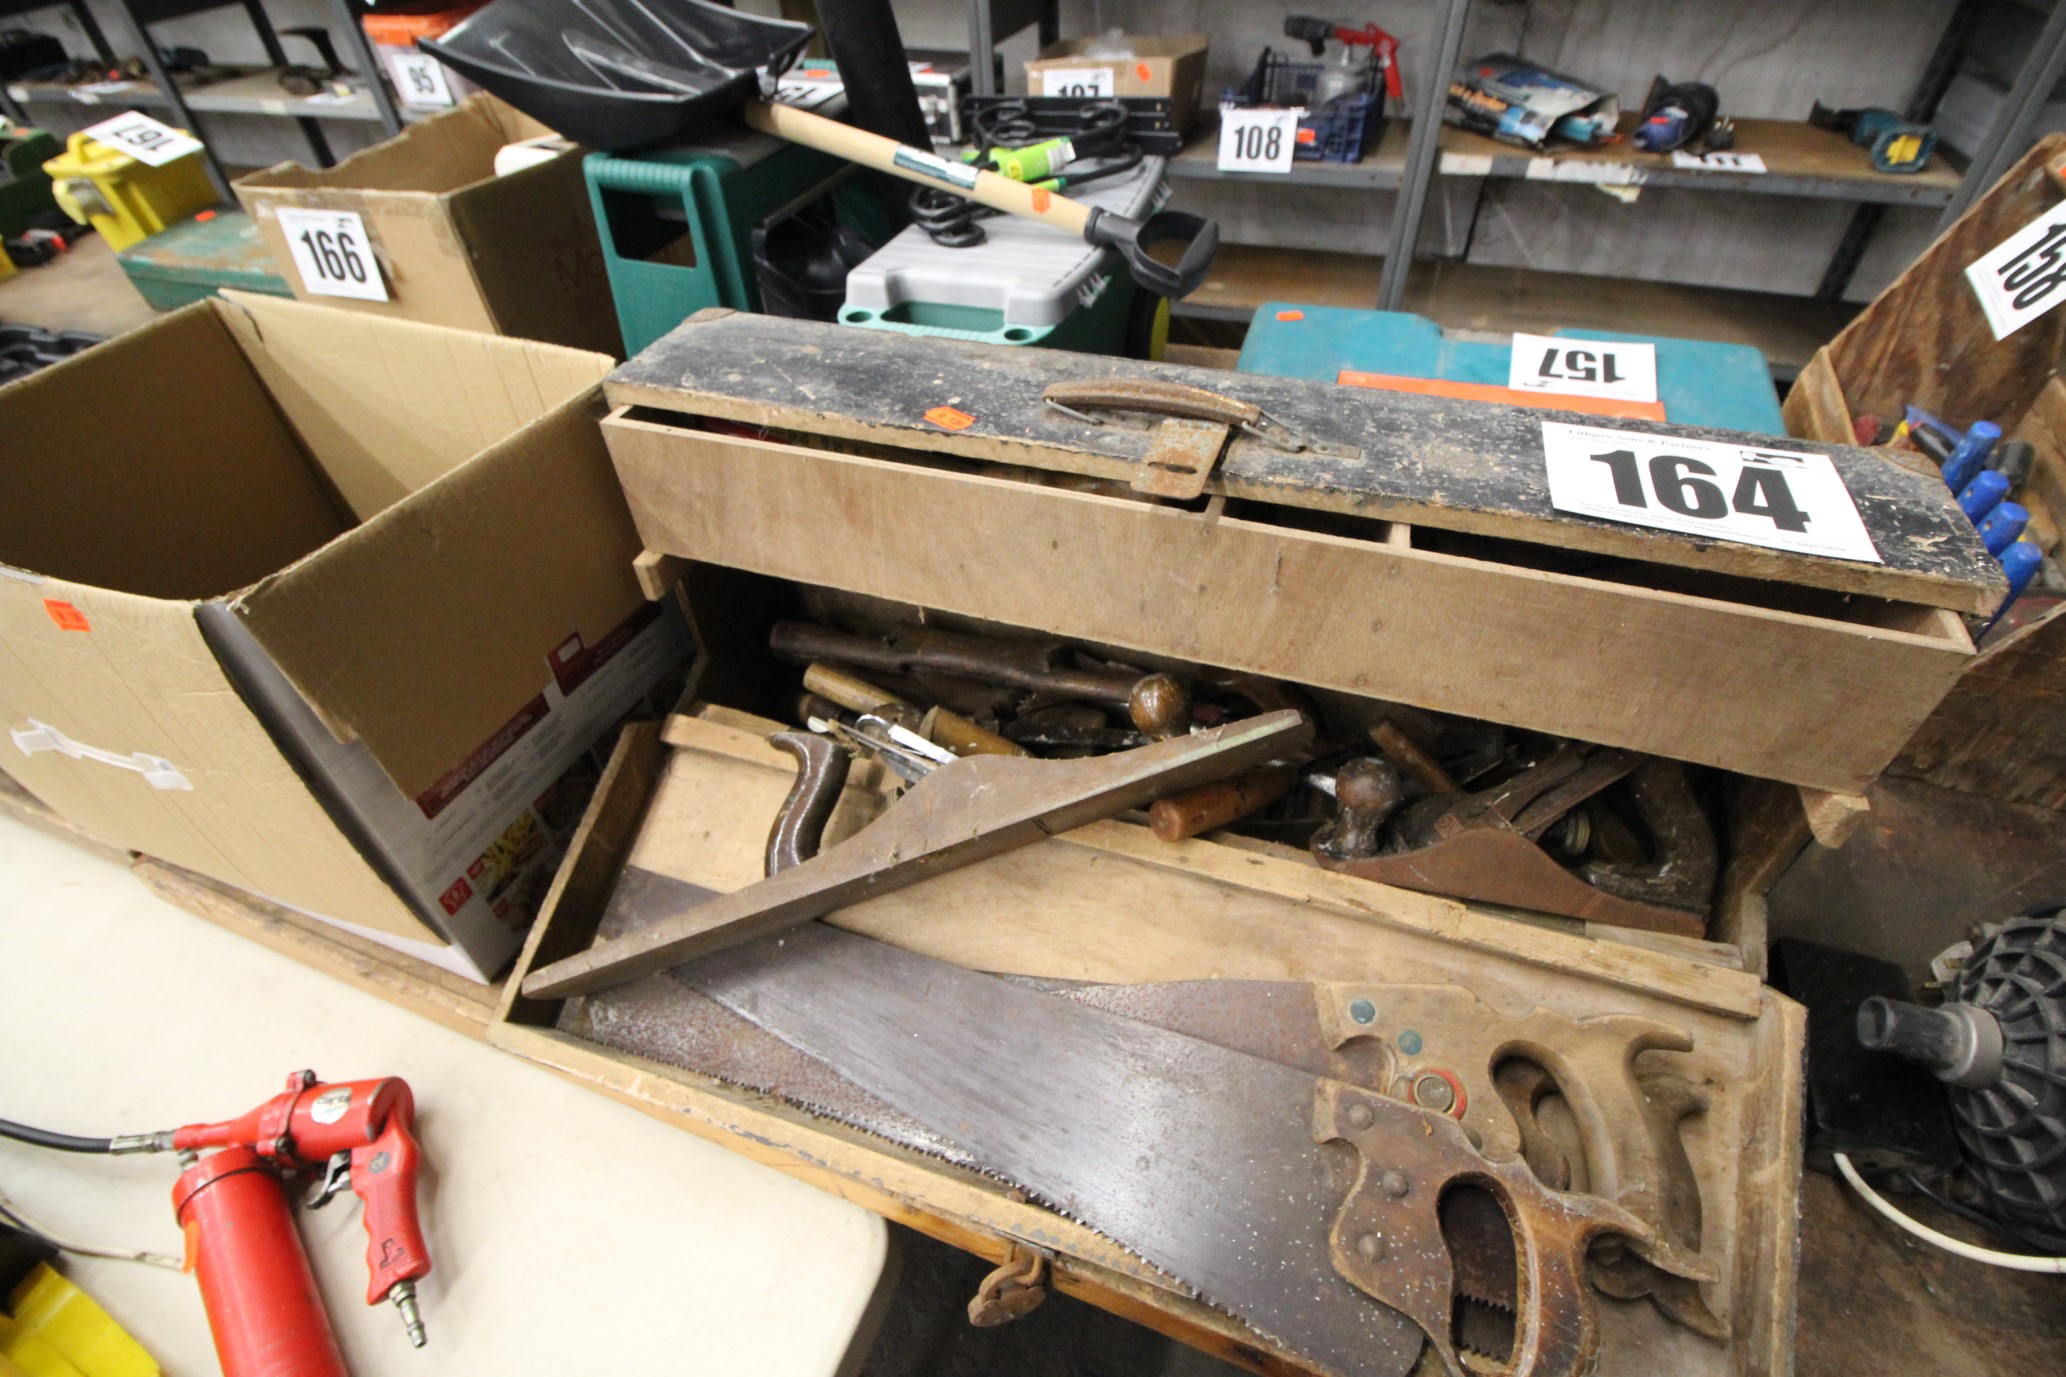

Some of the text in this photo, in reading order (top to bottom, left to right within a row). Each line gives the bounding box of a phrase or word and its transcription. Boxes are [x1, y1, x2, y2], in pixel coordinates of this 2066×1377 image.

[408, 66, 435, 93] 95
[112, 124, 174, 151] 167
[1233, 125, 1282, 160] 108
[300, 229, 367, 283] 166
[1997, 223, 2066, 310] 158
[1538, 347, 1626, 383] 157
[1589, 449, 1811, 534] 164
